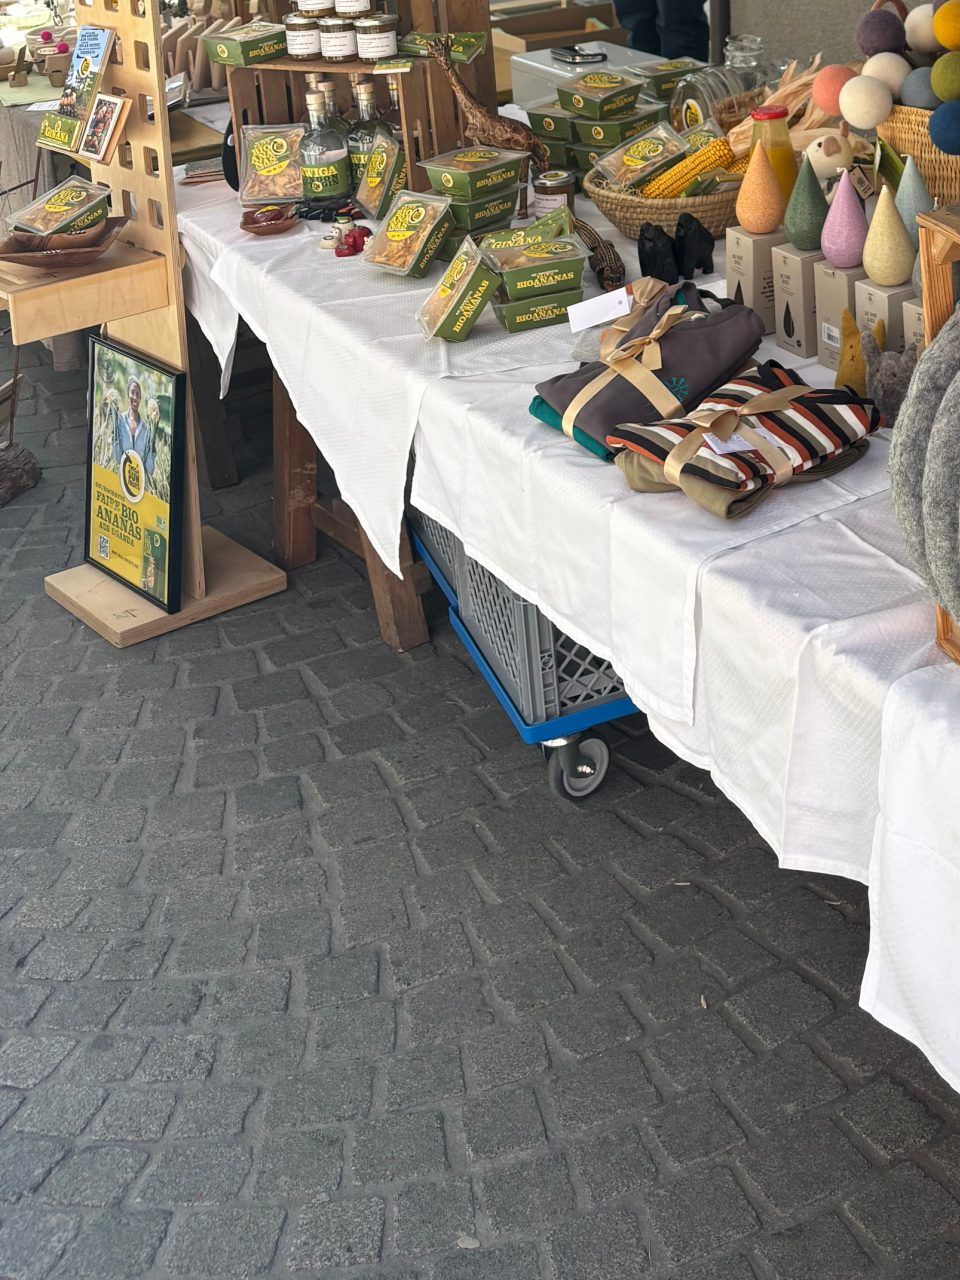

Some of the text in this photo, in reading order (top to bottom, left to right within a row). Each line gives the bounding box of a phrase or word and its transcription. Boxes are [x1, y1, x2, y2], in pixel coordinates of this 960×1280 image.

[322, 180, 340, 188] GIN
[476, 170, 516, 188] BIOANANAS
[475, 202, 512, 219] BIOANANAS
[419, 221, 450, 269] BIOANANAS
[516, 271, 574, 290] BIOANANAS
[453, 280, 489, 333] BIOANANAS
[515, 307, 569, 323] BIOANANA
[96, 505, 142, 541] ANANAS
[121, 503, 139, 525] BIO
[111, 528, 135, 547] UGANDA
